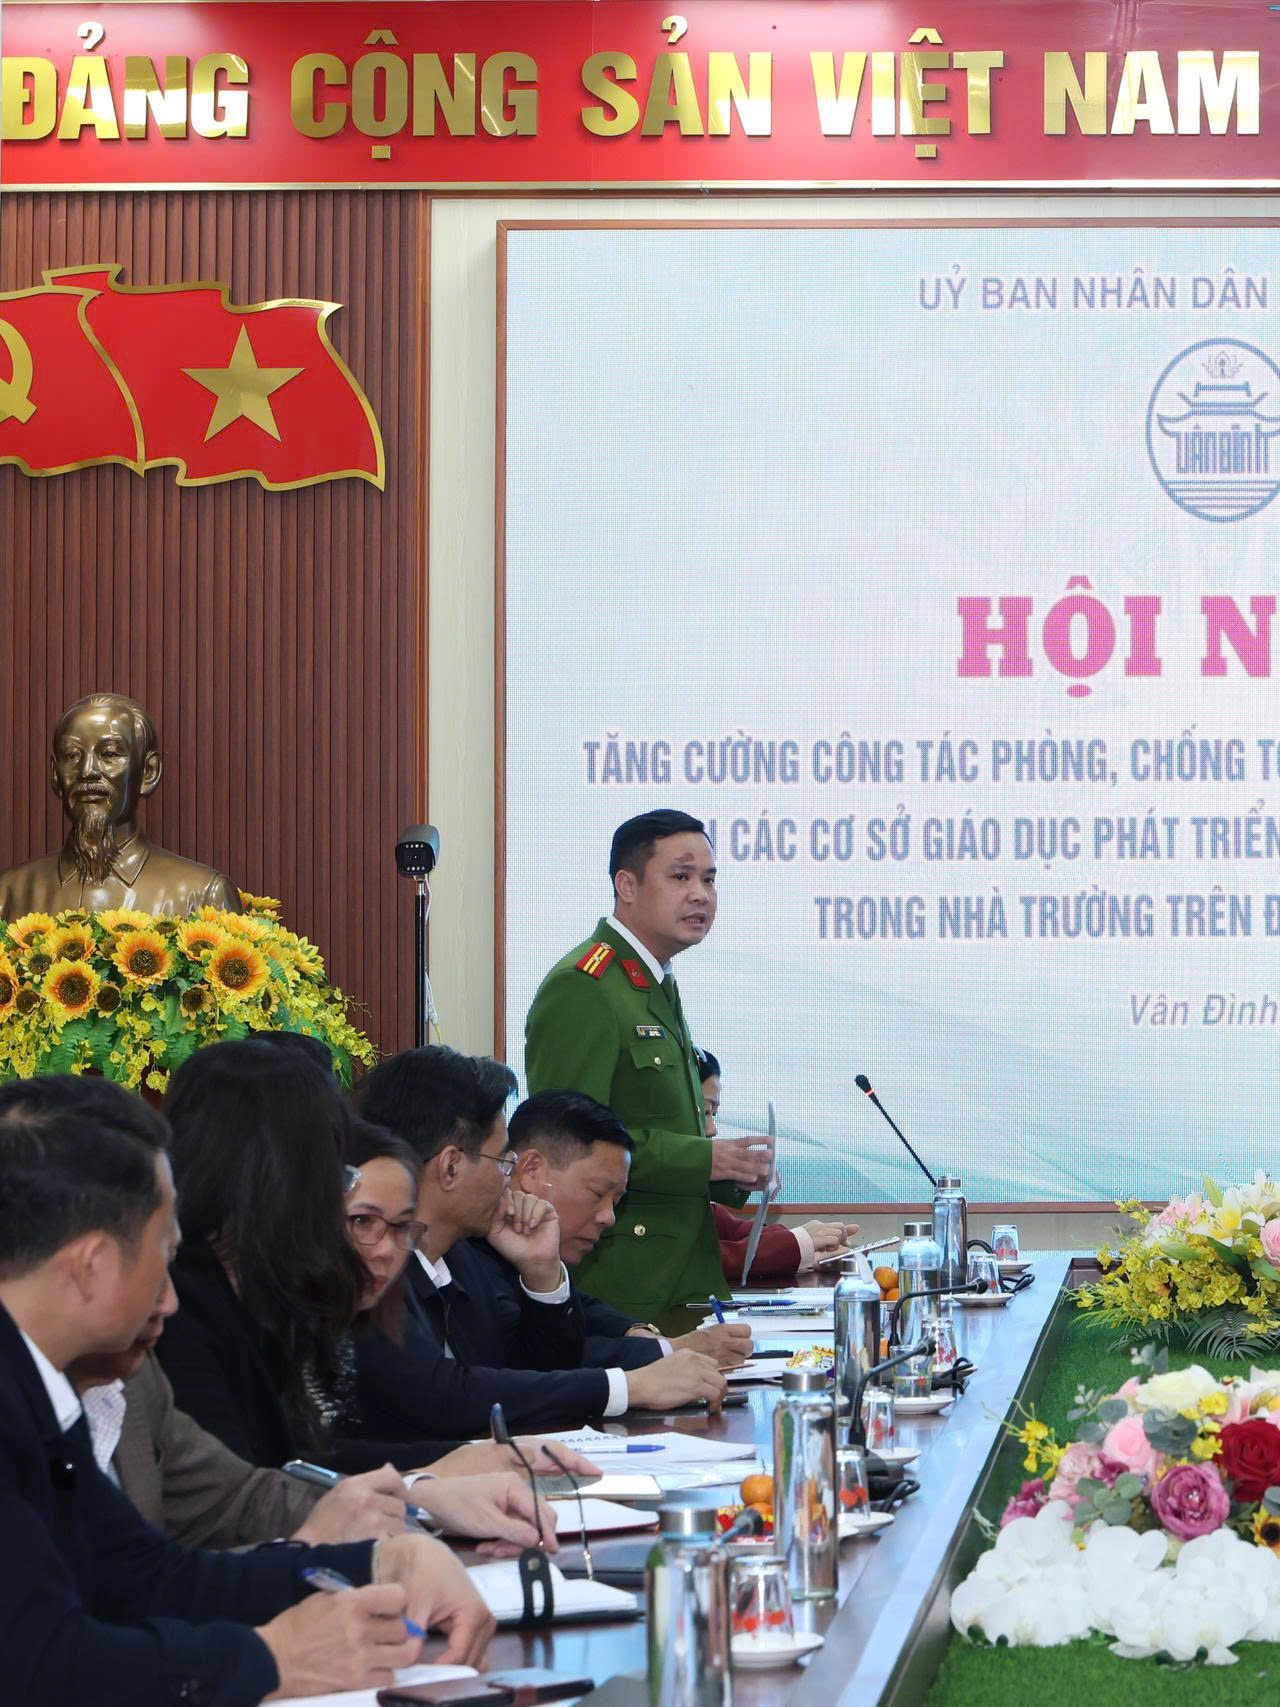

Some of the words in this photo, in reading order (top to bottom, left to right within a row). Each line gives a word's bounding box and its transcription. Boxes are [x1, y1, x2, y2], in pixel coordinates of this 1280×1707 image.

[0, 21, 250, 139] ĐẢNG
[290, 30, 539, 158] CỘNG
[581, 15, 772, 137] SẢN
[810, 28, 1003, 158] VIỆT
[1043, 50, 1259, 136] NAM
[919, 263, 967, 310] UỶ
[981, 277, 1058, 310] BAN
[1072, 267, 1177, 310] NHÂN
[1191, 267, 1269, 310] DÂN
[956, 575, 1162, 698] HỘI
[583, 731, 672, 785] TĂNG
[683, 730, 800, 785] CƯỜNG
[811, 731, 904, 784] CÔNG
[916, 729, 980, 784] TÁC
[991, 728, 1118, 788] PHÒNG,
[1130, 722, 1246, 783] CHỐNG
[730, 809, 797, 862] CÁC
[810, 814, 856, 862] CƠ
[866, 802, 911, 862] SỞ
[923, 806, 1001, 862] GIÁO
[1014, 816, 1081, 870] DỤC
[1093, 806, 1180, 861] PHÁT
[814, 896, 926, 940] TRONG
[938, 886, 1008, 940] NHÀ
[1019, 883, 1155, 939] TRƯỜNG
[1166, 885, 1253, 938] TRÊN
[1130, 994, 1188, 1027] Vân
